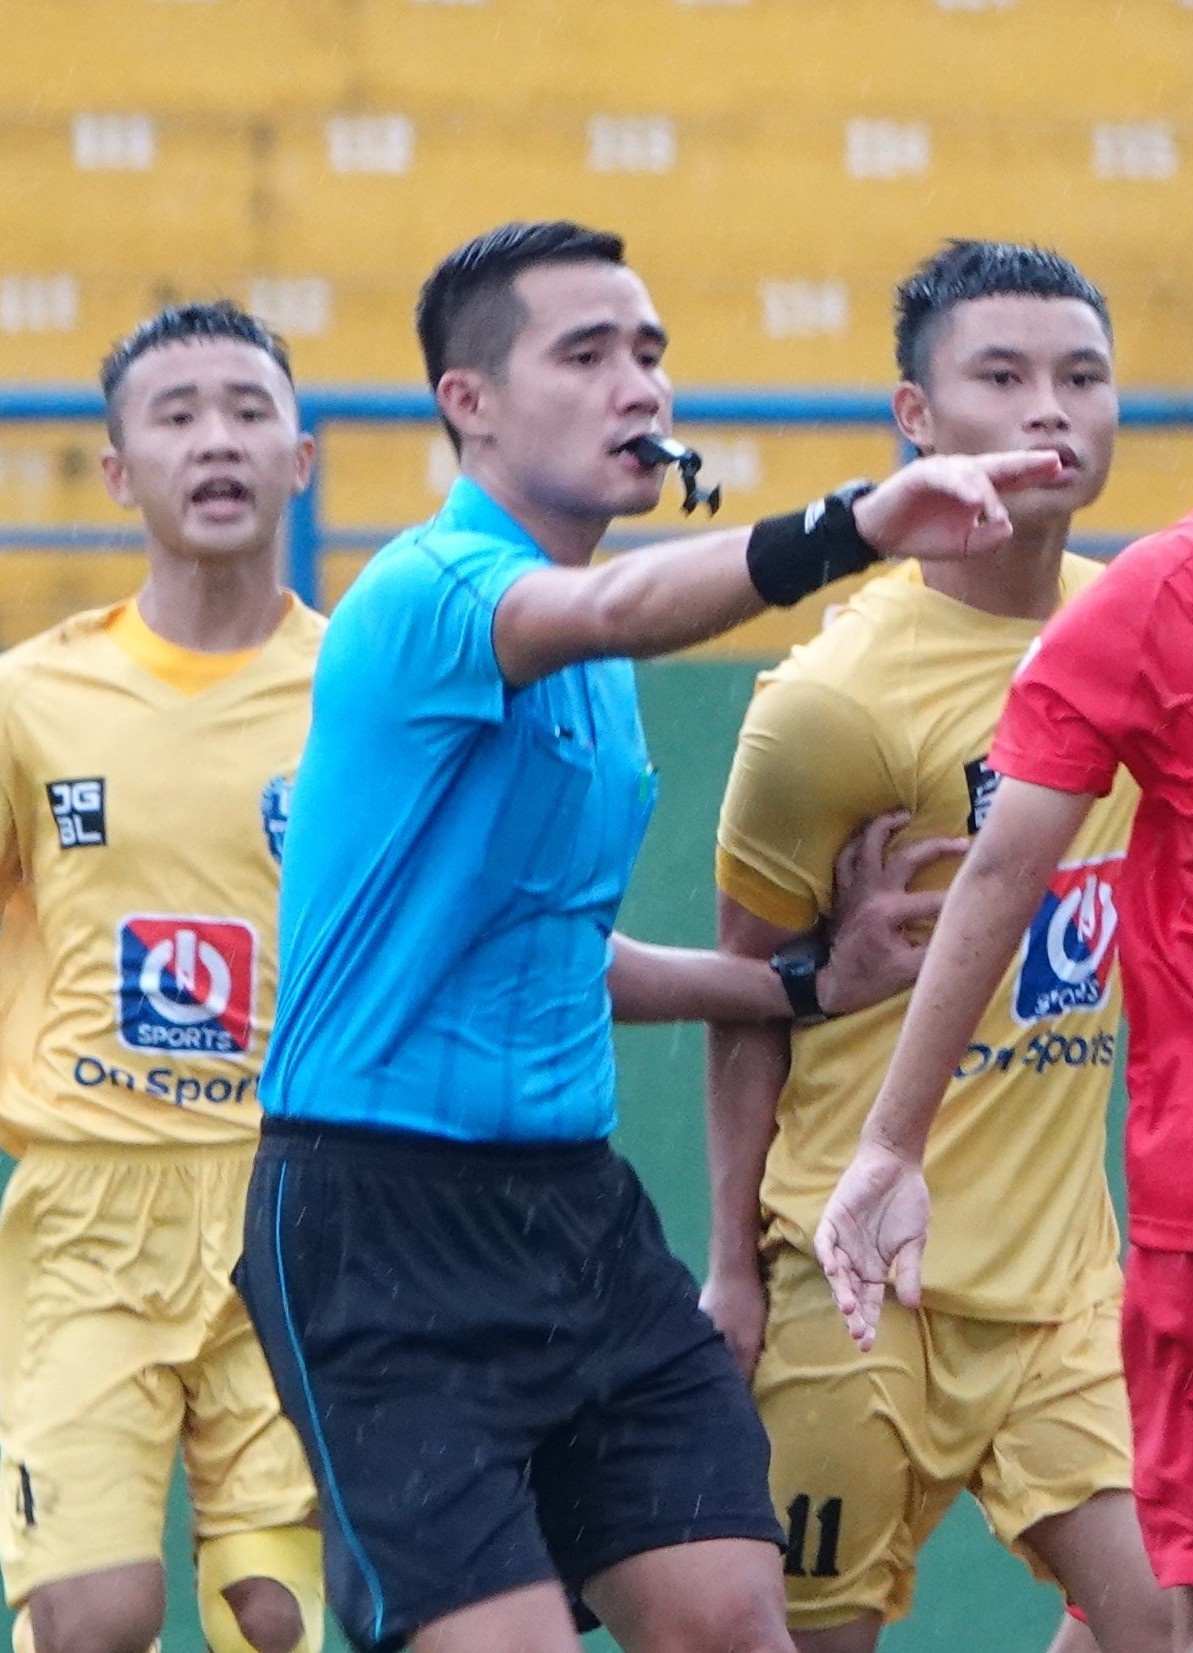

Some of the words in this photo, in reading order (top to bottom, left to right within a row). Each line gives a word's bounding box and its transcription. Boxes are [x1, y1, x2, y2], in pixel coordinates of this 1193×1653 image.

[137, 1023, 233, 1051] SPORTS
[74, 1056, 136, 1092] On
[145, 1067, 262, 1106] Spor
[783, 1493, 843, 1576] 11
